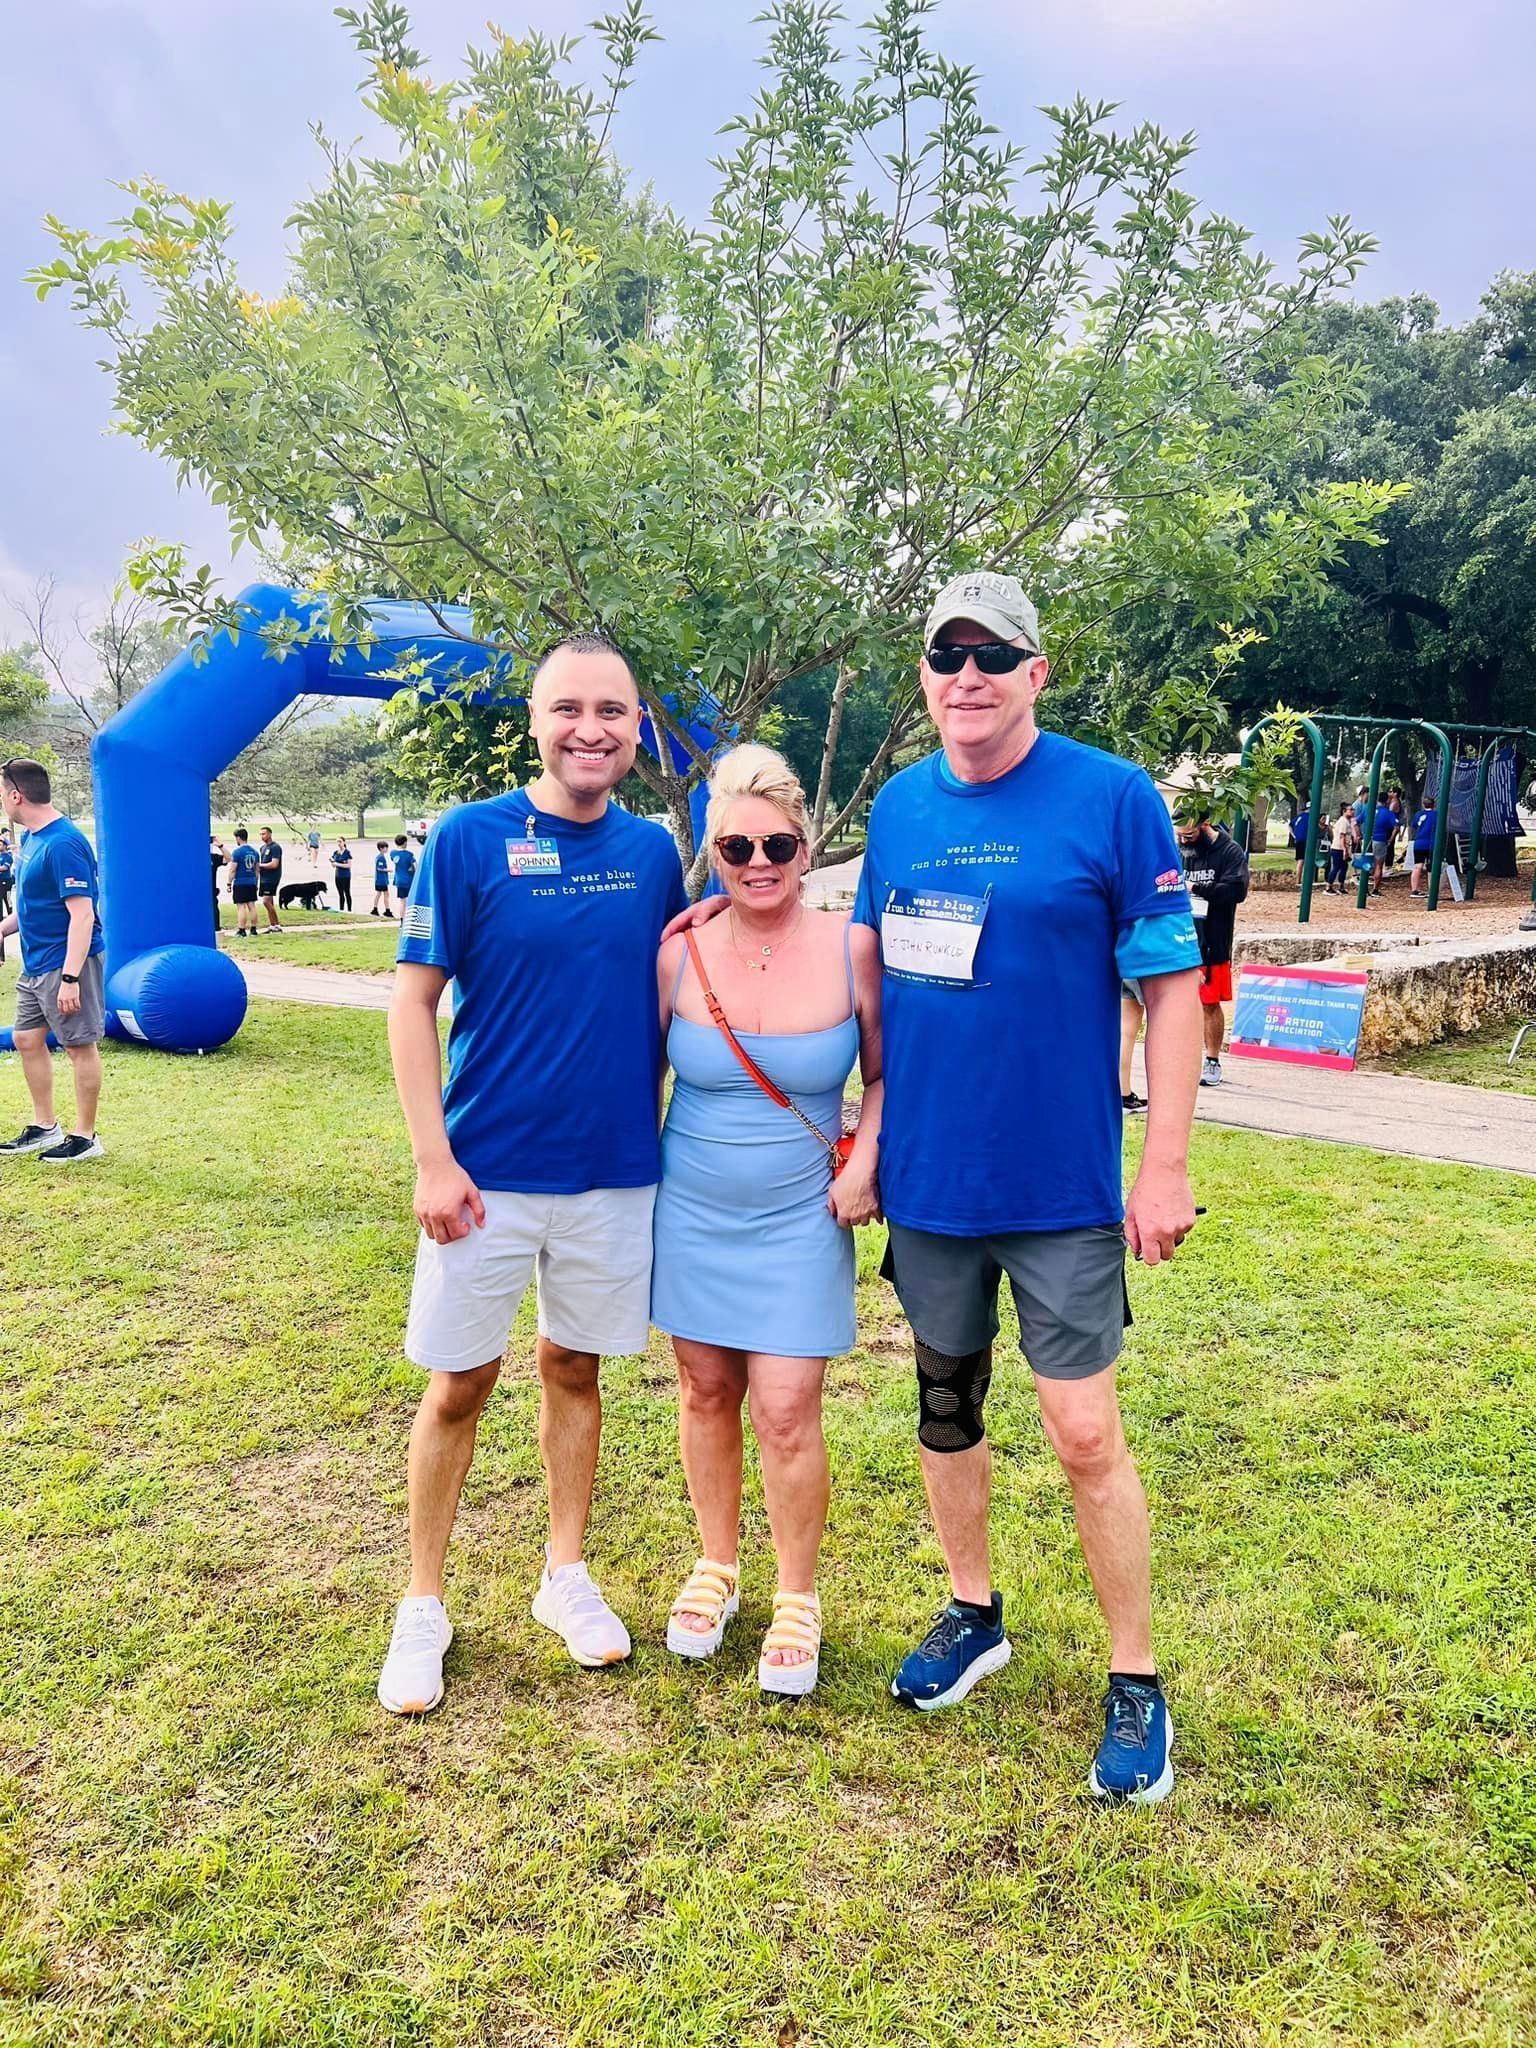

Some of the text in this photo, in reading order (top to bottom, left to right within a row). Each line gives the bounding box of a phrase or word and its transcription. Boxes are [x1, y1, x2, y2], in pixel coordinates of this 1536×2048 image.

[946, 841, 1021, 855] wear blue:
[512, 856, 557, 866] JOHNNY
[911, 853, 1019, 871] run to remember
[571, 870, 636, 883] wear blue:
[532, 881, 637, 896] run to remember
[891, 904, 976, 922] run to remember
[913, 897, 980, 916] wear blue:
[1251, 993, 1276, 1002] PARTNERS
[1277, 995, 1291, 1003] MAKE
[1298, 997, 1325, 1007] POSSIBLE.
[1327, 1000, 1345, 1009] THANK
[1263, 1023, 1323, 1037] APPRECIATION
[1125, 1685, 1146, 1696] HOKA
